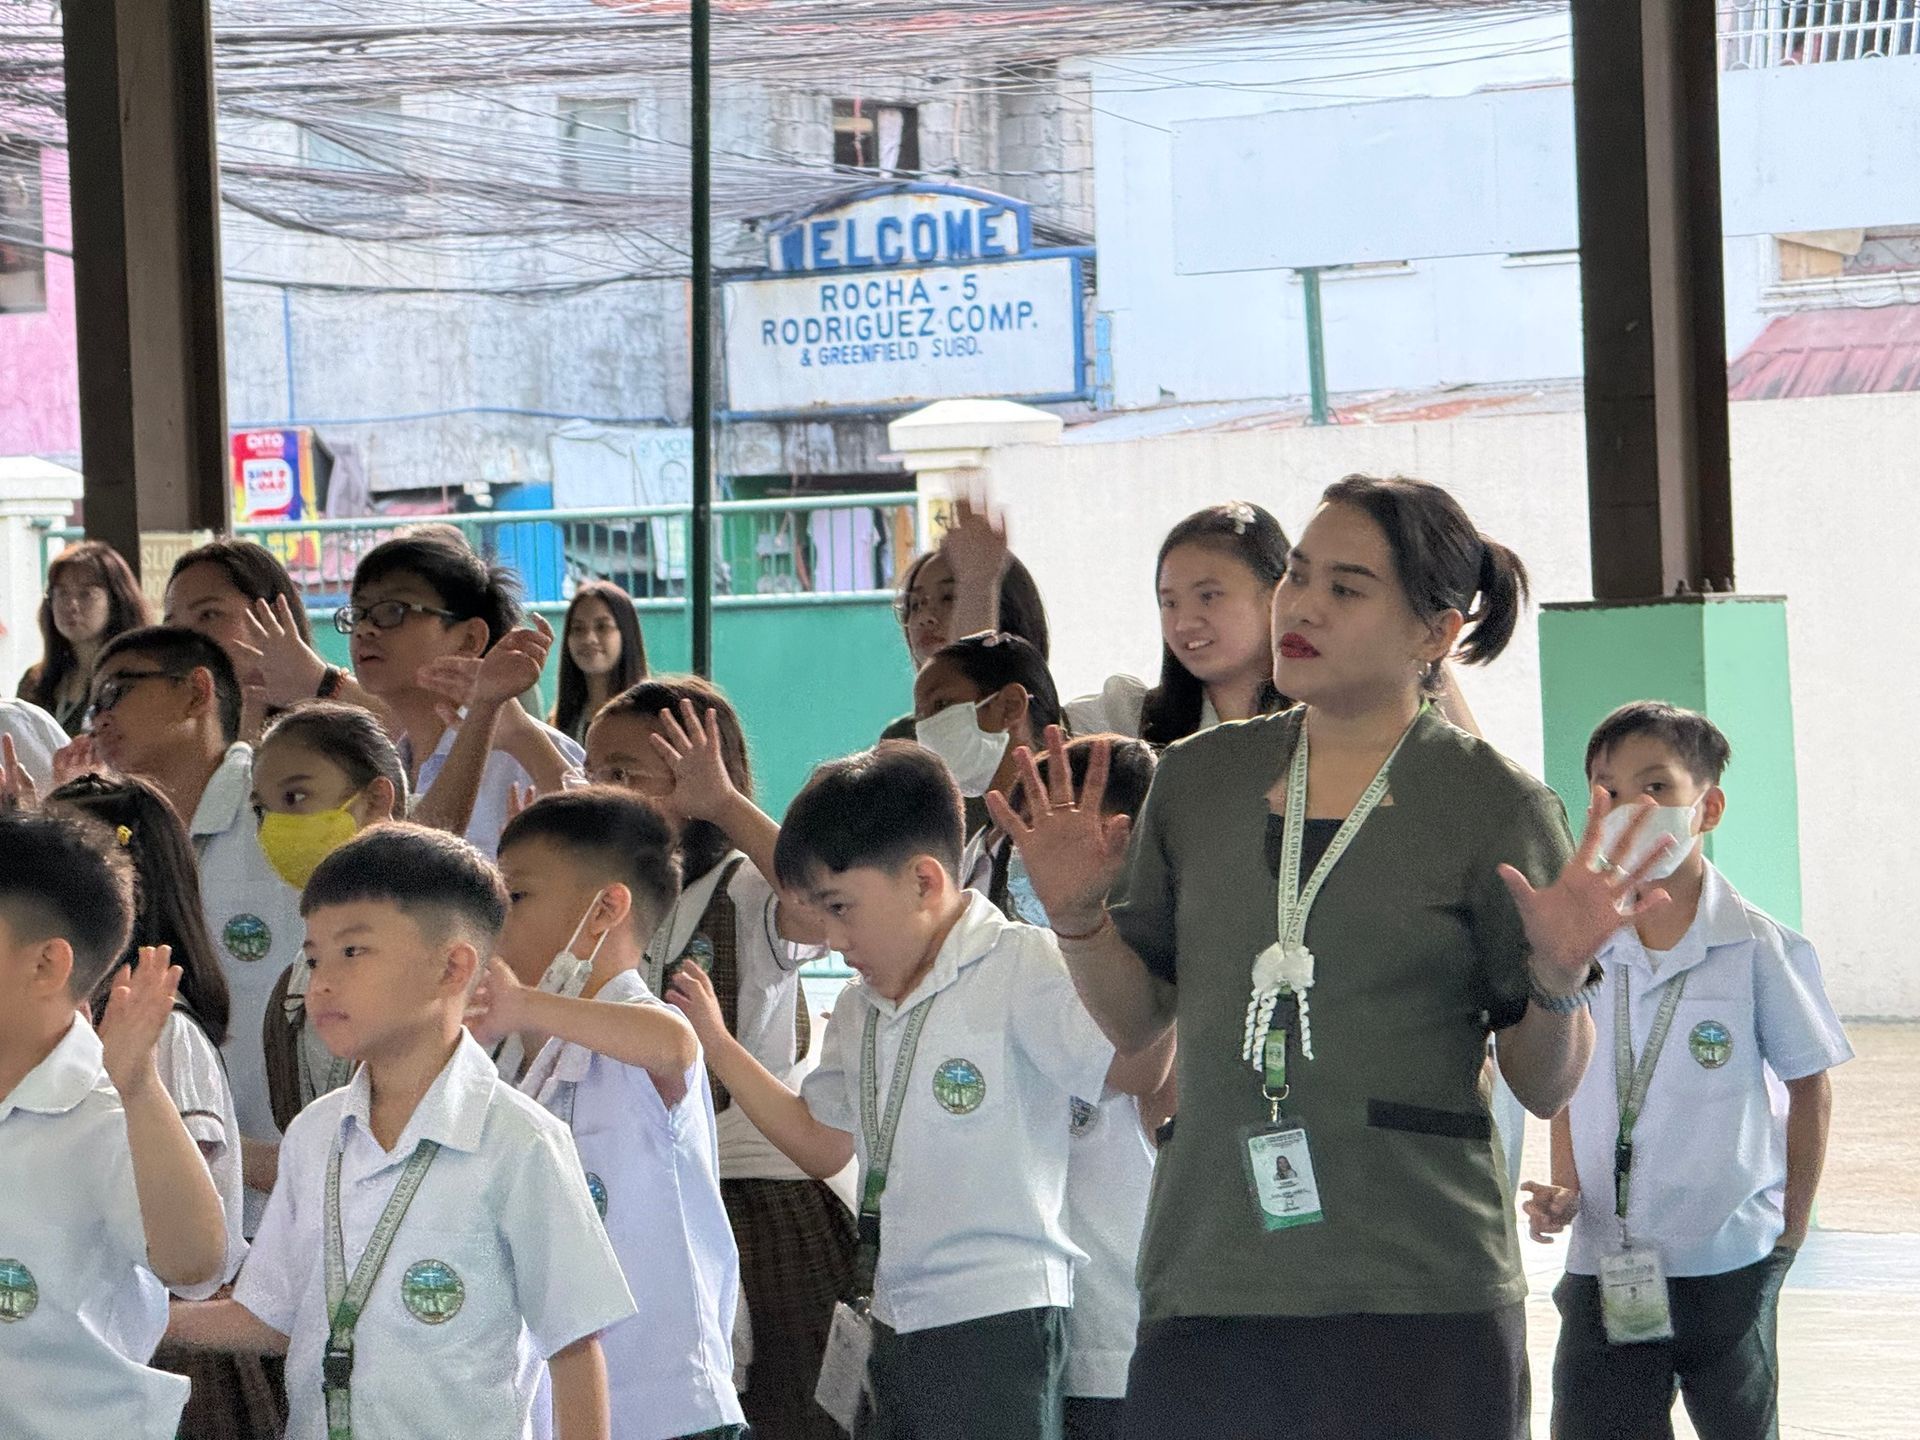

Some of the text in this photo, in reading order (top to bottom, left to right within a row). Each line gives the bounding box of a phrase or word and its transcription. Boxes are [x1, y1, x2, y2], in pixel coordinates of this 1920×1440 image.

[821, 277, 930, 311] ROCHA
[962, 273, 978, 301] 5
[761, 301, 1038, 346] RODRIGUEZ COMP.
[800, 347, 812, 367] &
[818, 341, 919, 366] GREENFIELD
